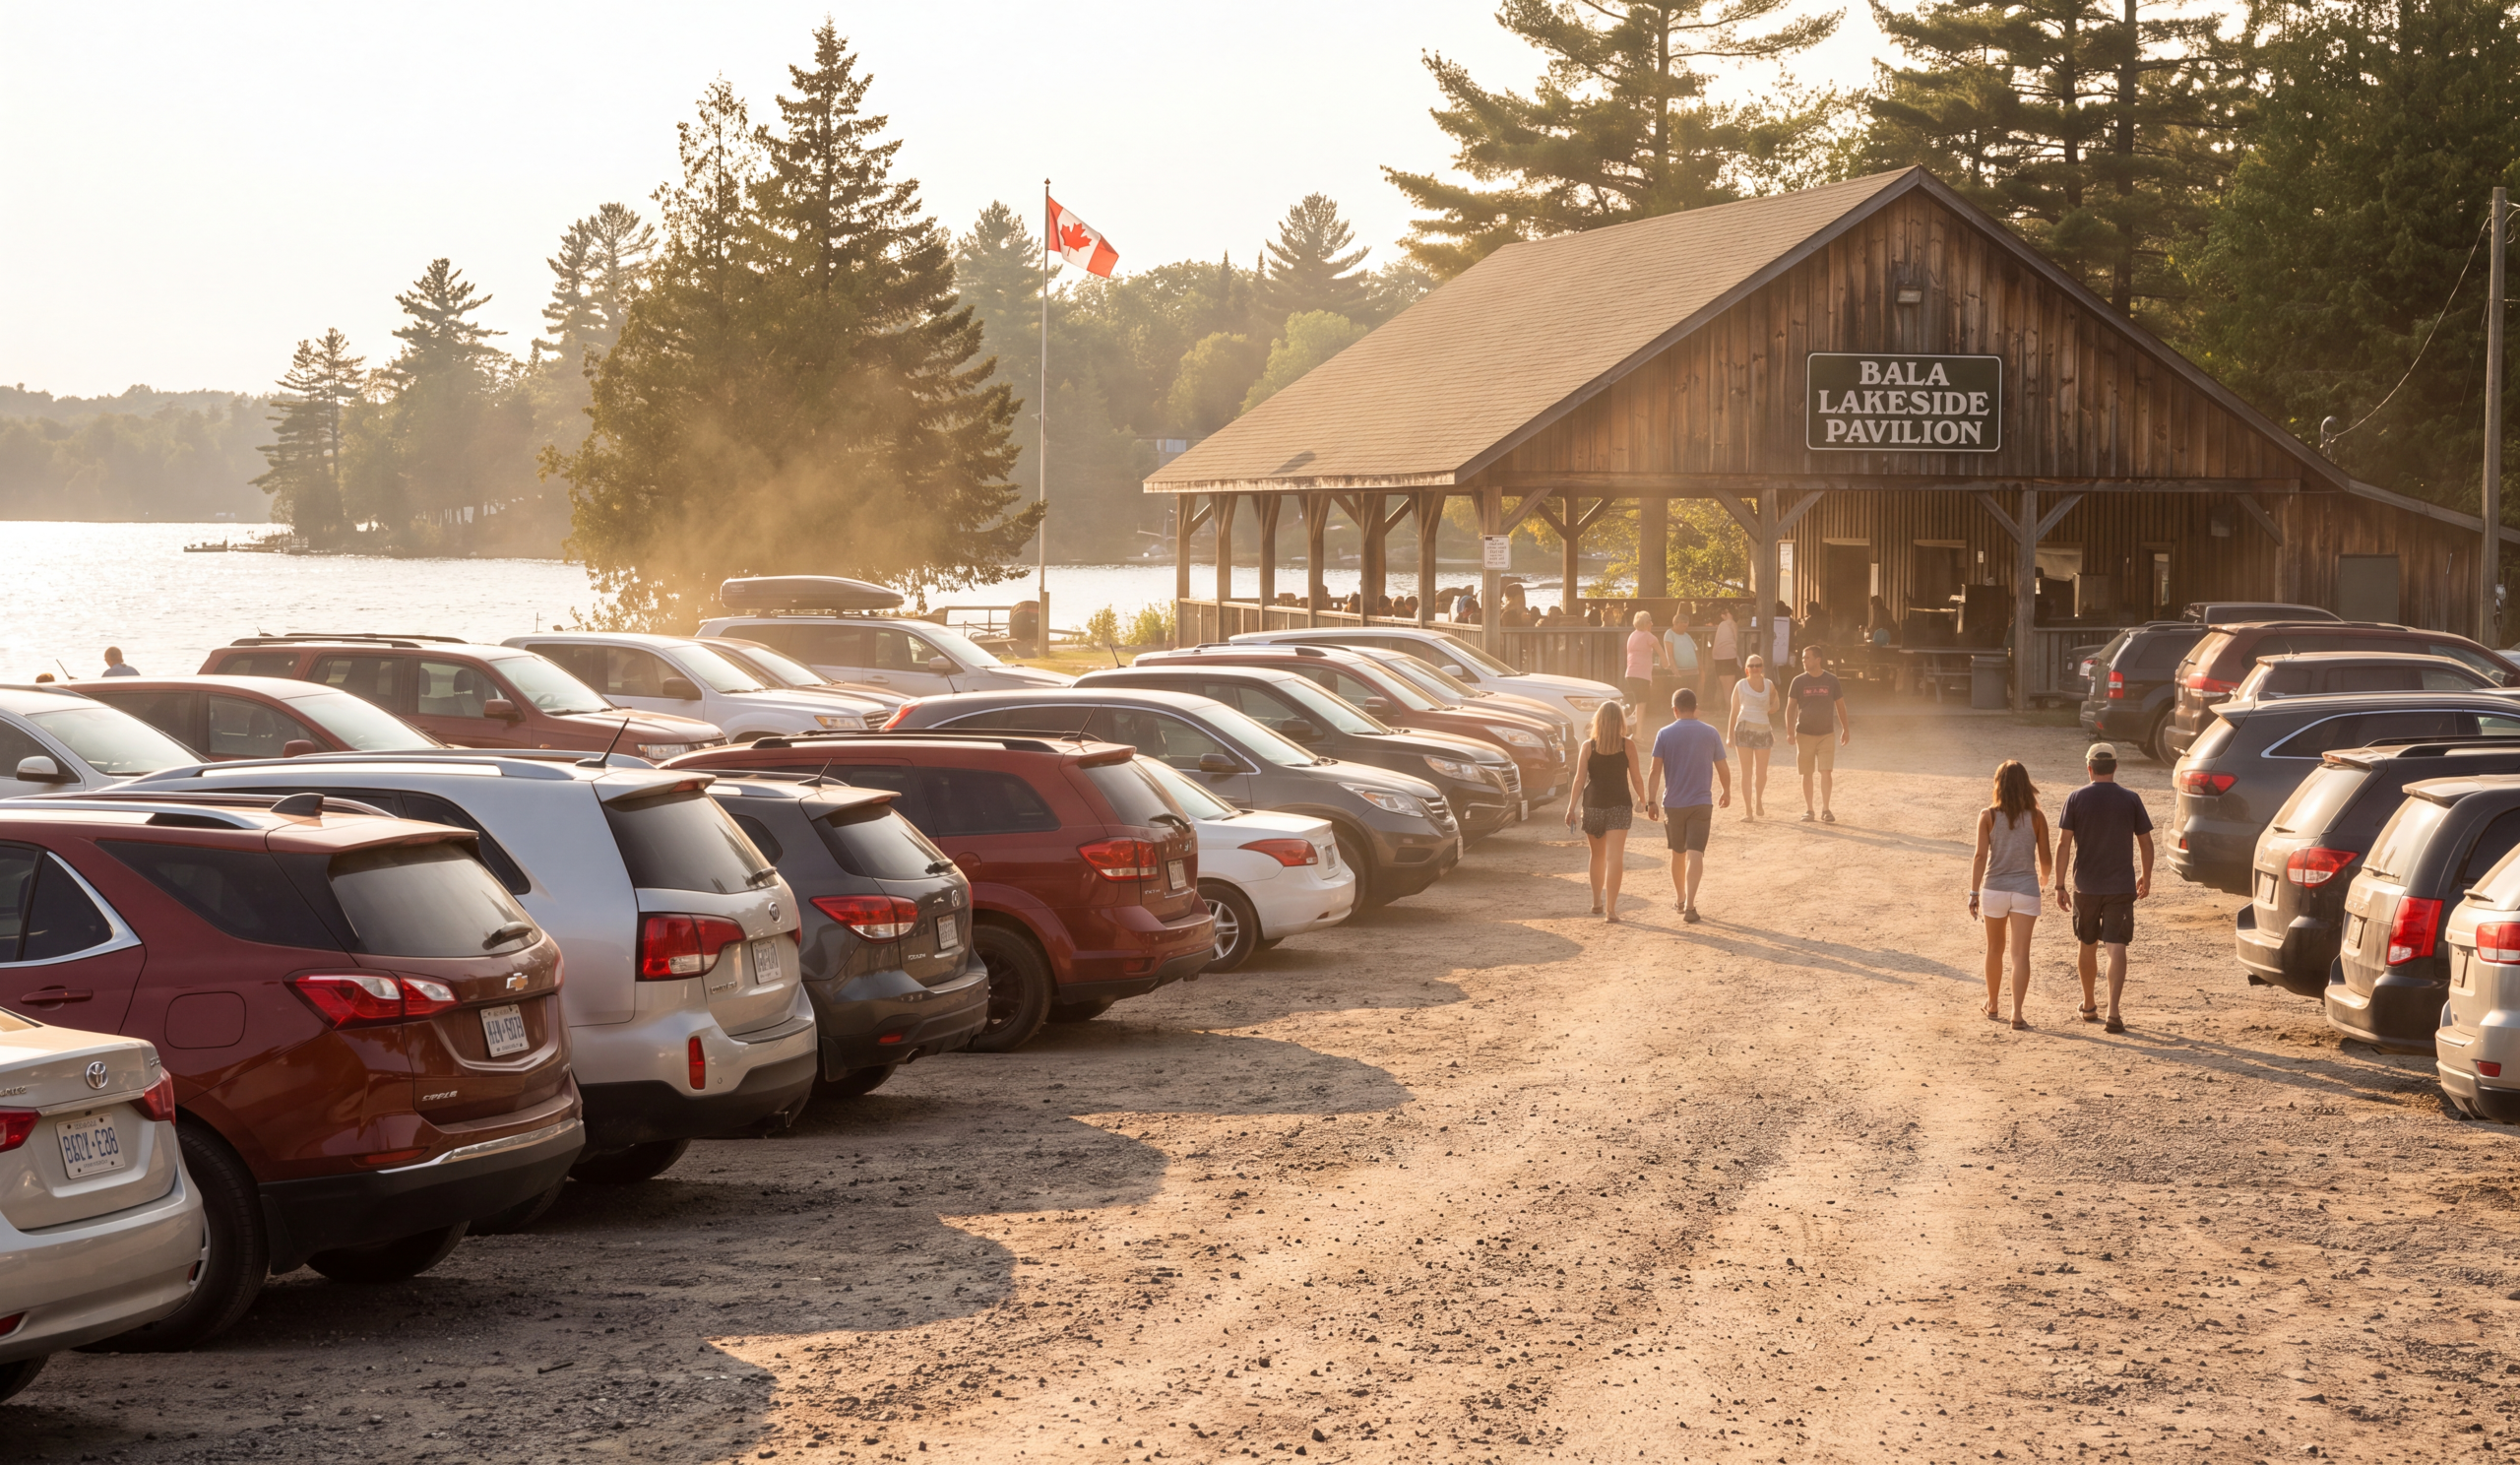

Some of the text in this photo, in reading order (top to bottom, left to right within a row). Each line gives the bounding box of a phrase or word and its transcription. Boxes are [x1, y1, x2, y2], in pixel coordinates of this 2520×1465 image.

[1859, 360, 1950, 386] BALA
[1818, 390, 1989, 415] LAKESIDE
[1825, 418, 1983, 444] PAVILION
